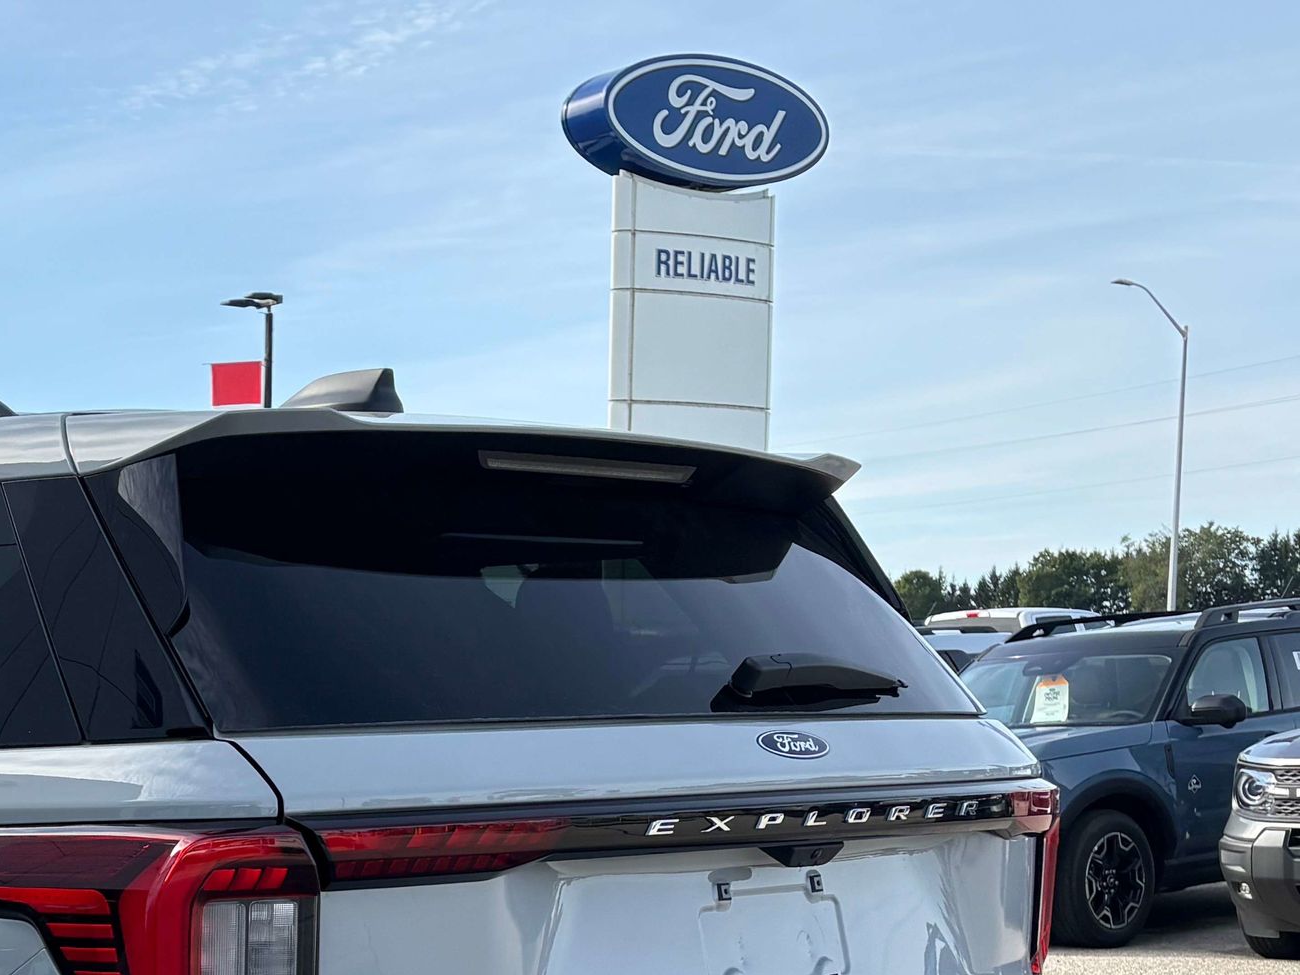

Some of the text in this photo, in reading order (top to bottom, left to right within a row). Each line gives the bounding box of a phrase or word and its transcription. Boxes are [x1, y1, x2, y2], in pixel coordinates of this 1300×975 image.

[653, 74, 787, 162] Ford
[656, 248, 756, 285] RELIABLE
[773, 733, 819, 752] Ford
[645, 800, 981, 836] EXPLORER
